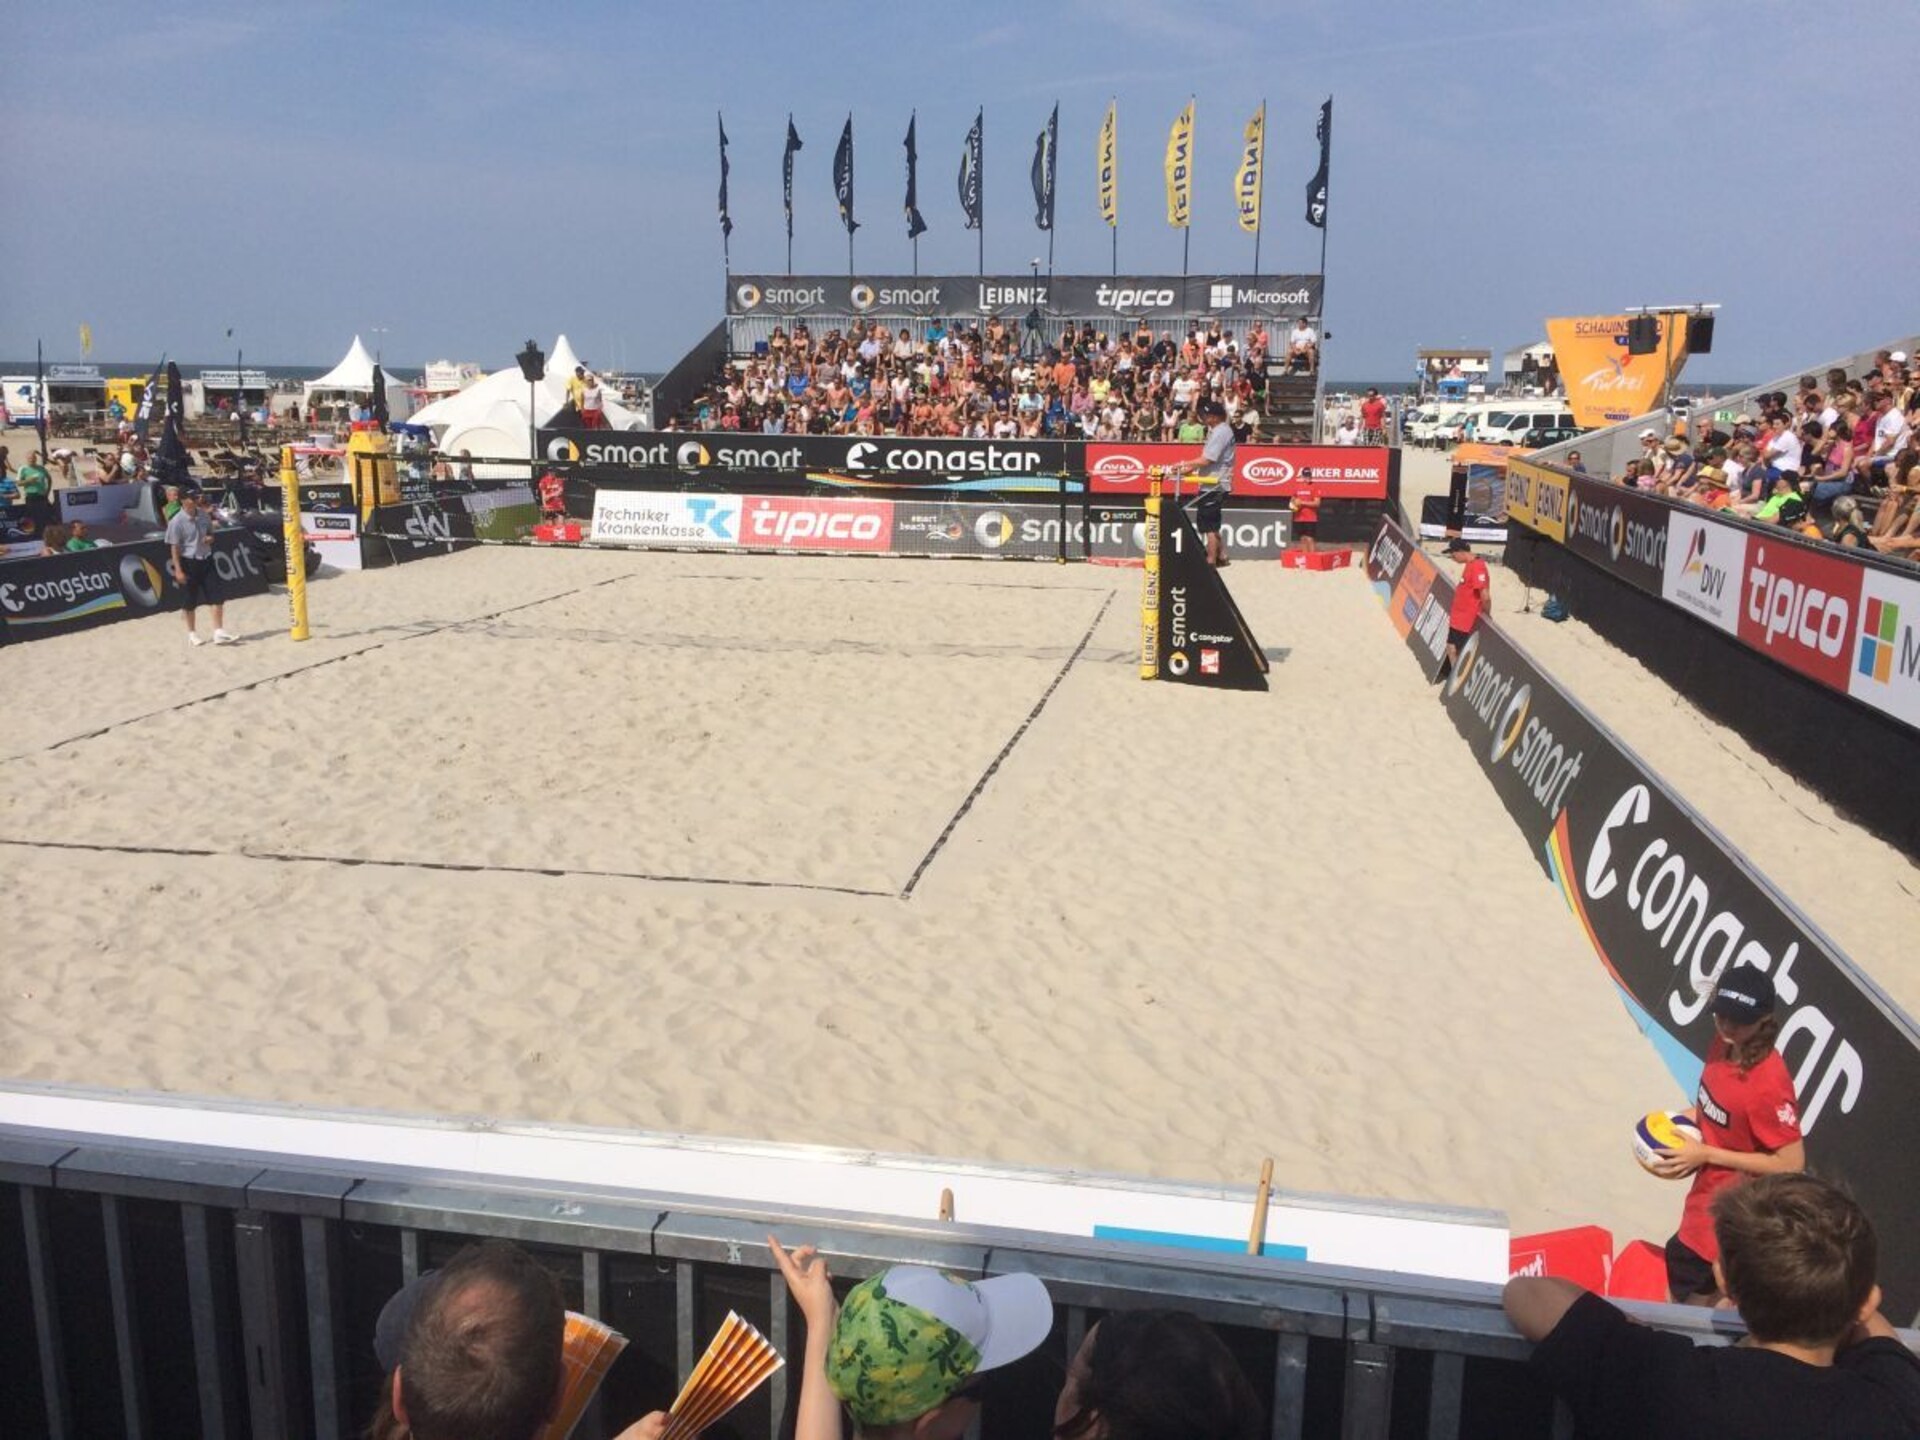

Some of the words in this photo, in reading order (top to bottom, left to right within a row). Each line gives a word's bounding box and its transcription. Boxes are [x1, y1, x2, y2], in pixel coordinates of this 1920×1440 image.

[765, 286, 825, 304] smart
[879, 286, 940, 305] smart
[979, 283, 1047, 309] LEIBNIZ
[1096, 283, 1175, 311] tipico
[1237, 288, 1310, 305] Microsoft
[586, 443, 669, 465] smart
[717, 447, 802, 467] smart
[1250, 466, 1285, 477] OYAK
[1344, 468, 1379, 479] BANK
[318, 490, 341, 499] smart
[598, 507, 669, 523] Techniker
[752, 501, 881, 543] tipico
[1579, 502, 1609, 545] smart
[597, 520, 704, 538] Krankenkasse
[1171, 528, 1183, 553] 1
[1624, 520, 1667, 571] smart
[24, 571, 112, 602] congstar
[1700, 563, 1726, 600] DVV
[1749, 546, 1849, 658] tipico
[1171, 587, 1186, 648] smart
[1463, 655, 1514, 730] smart
[1511, 716, 1583, 820] smart
